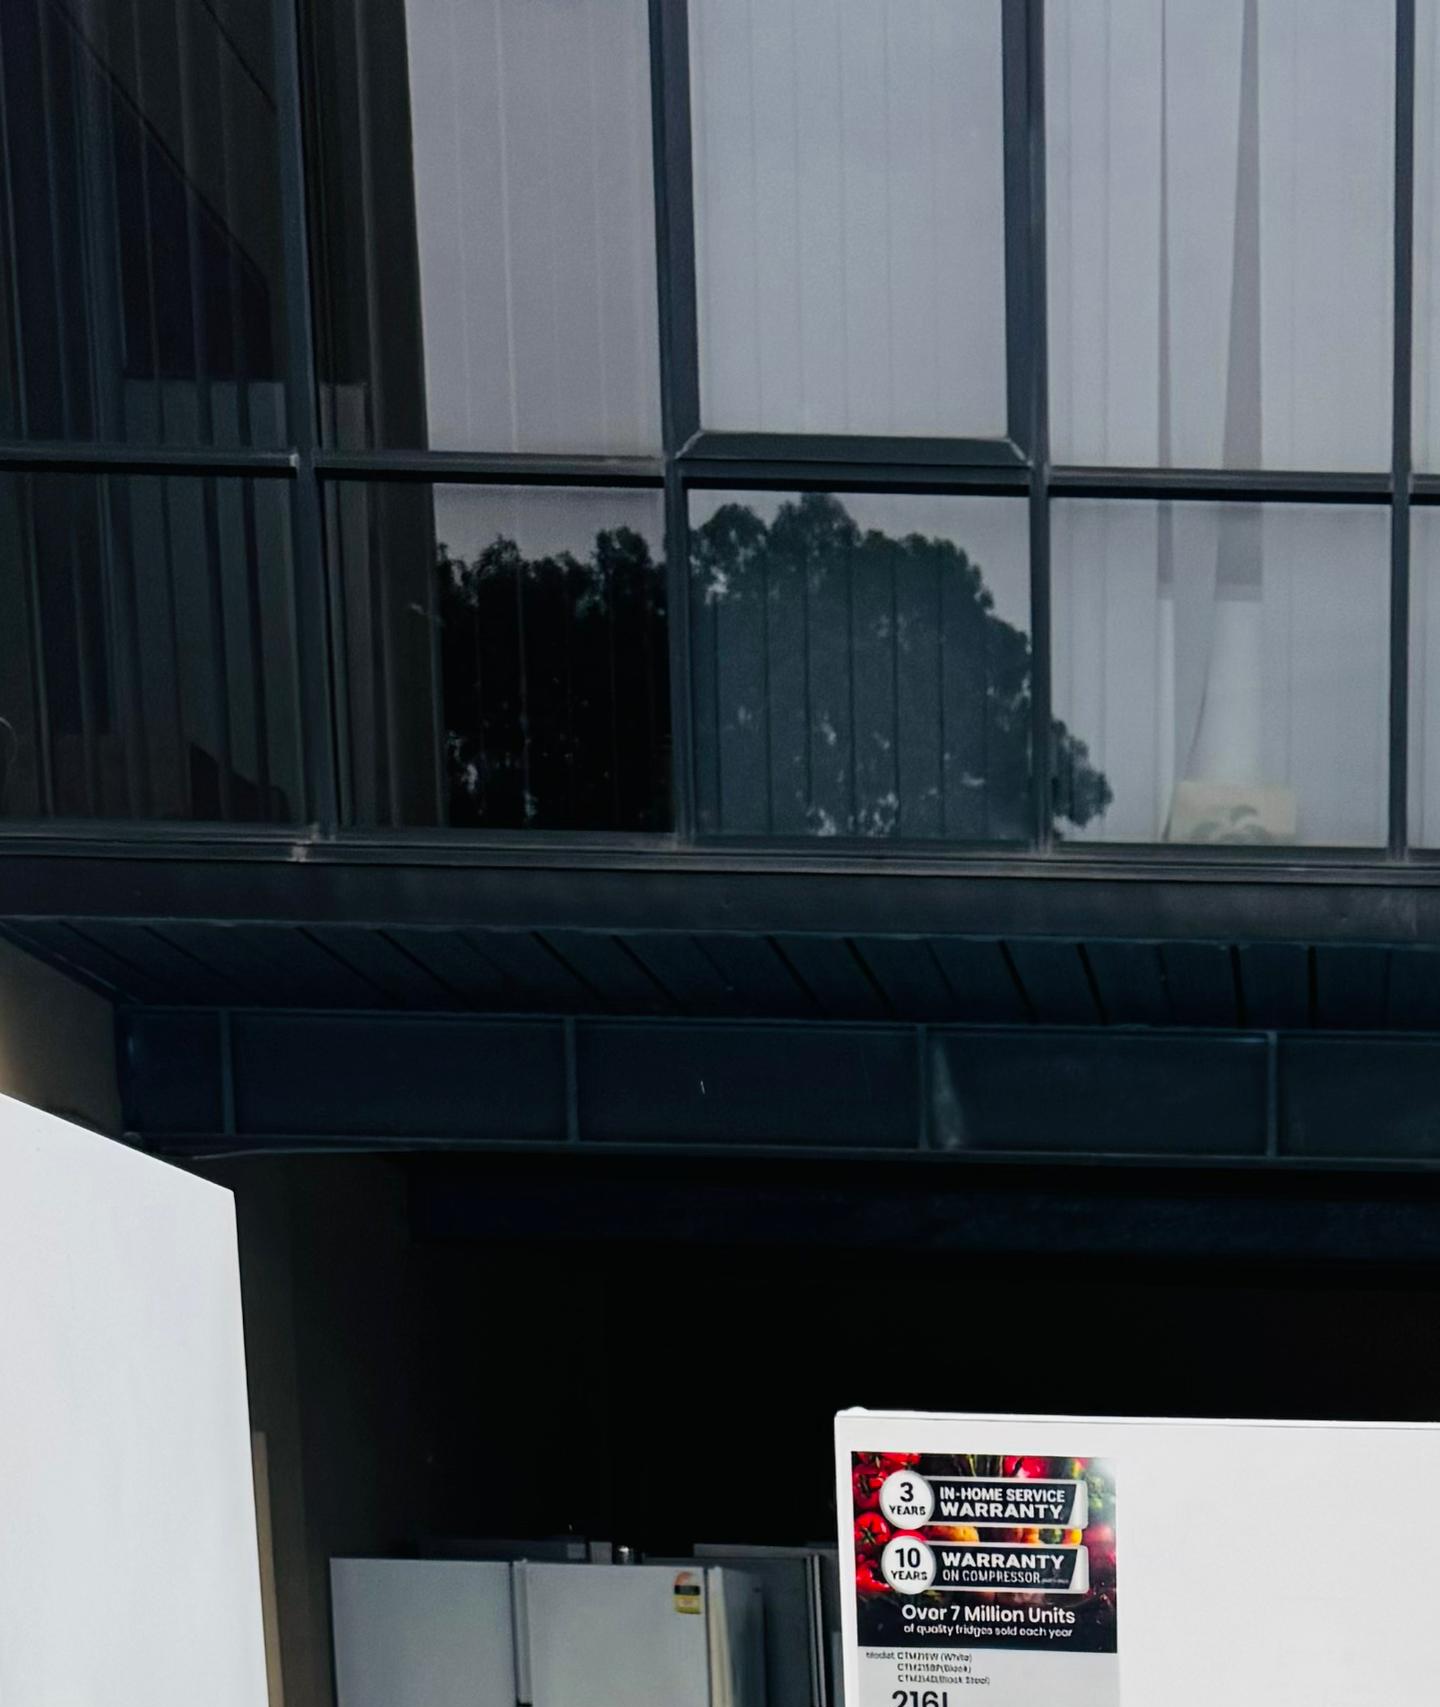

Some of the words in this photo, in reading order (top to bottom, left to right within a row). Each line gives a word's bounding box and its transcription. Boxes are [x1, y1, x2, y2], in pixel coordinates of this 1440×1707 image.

[900, 1482, 914, 1503] 3
[940, 1487, 1003, 1501] IN-HOME
[1006, 1488, 1066, 1503] SERVICE
[889, 1505, 926, 1516] YEARS
[940, 1502, 1063, 1519] WARRANTY
[895, 1548, 921, 1568] 10
[941, 1552, 1064, 1570] WARRANTY
[891, 1571, 928, 1581] YEARS
[943, 1570, 959, 1582] ON
[962, 1570, 1040, 1584] COMPRESSOR
[902, 1604, 947, 1620] Over
[950, 1605, 960, 1621] 7
[964, 1605, 1025, 1622] Million
[1028, 1606, 1076, 1624] Units
[903, 1623, 914, 1633] of
[917, 1624, 953, 1636] quality
[955, 1624, 993, 1638] fridges
[995, 1625, 1017, 1636] sold
[1019, 1625, 1047, 1636] each
[1048, 1628, 1073, 1639] year
